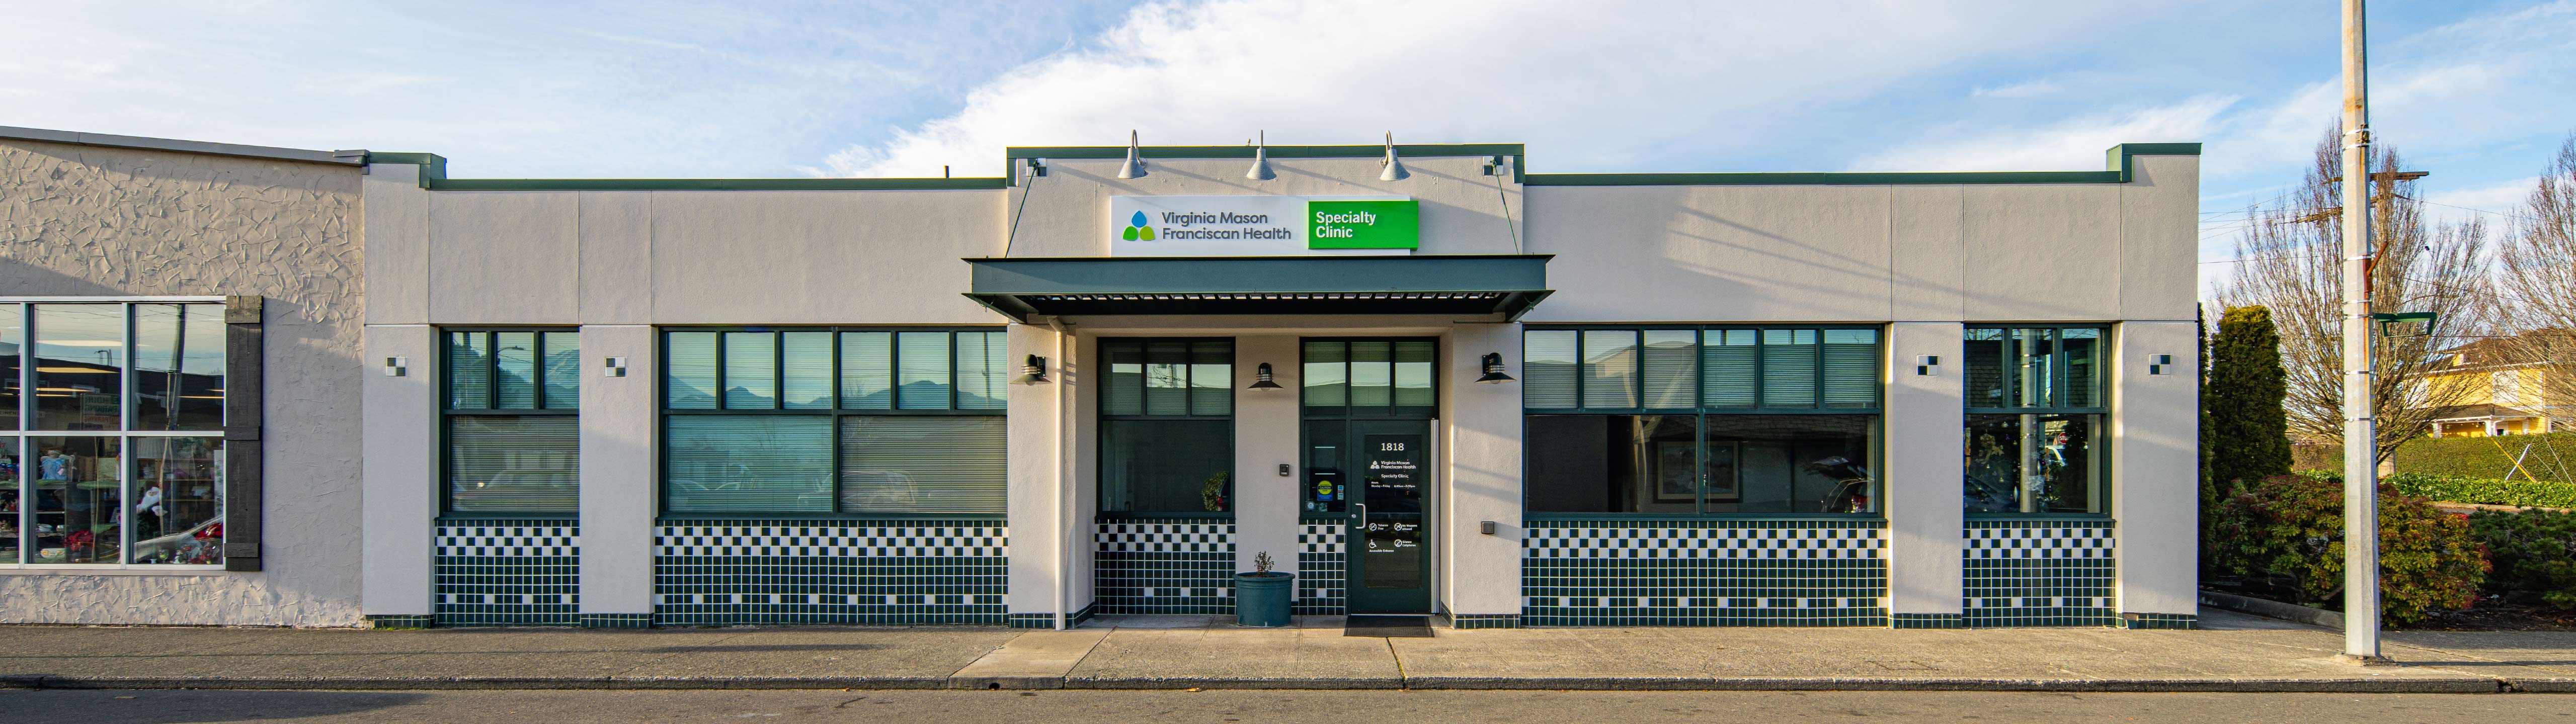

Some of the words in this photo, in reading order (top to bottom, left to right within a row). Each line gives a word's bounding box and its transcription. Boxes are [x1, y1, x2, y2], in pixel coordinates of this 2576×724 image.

[1162, 211, 1216, 227] Virginia
[1220, 212, 1268, 224] Mason
[1316, 211, 1376, 226] Specialty
[1162, 228, 1241, 240] Franciscan
[1244, 227, 1291, 240] Health
[1316, 226, 1353, 238] Clinic
[1381, 442, 1404, 451] 1818
